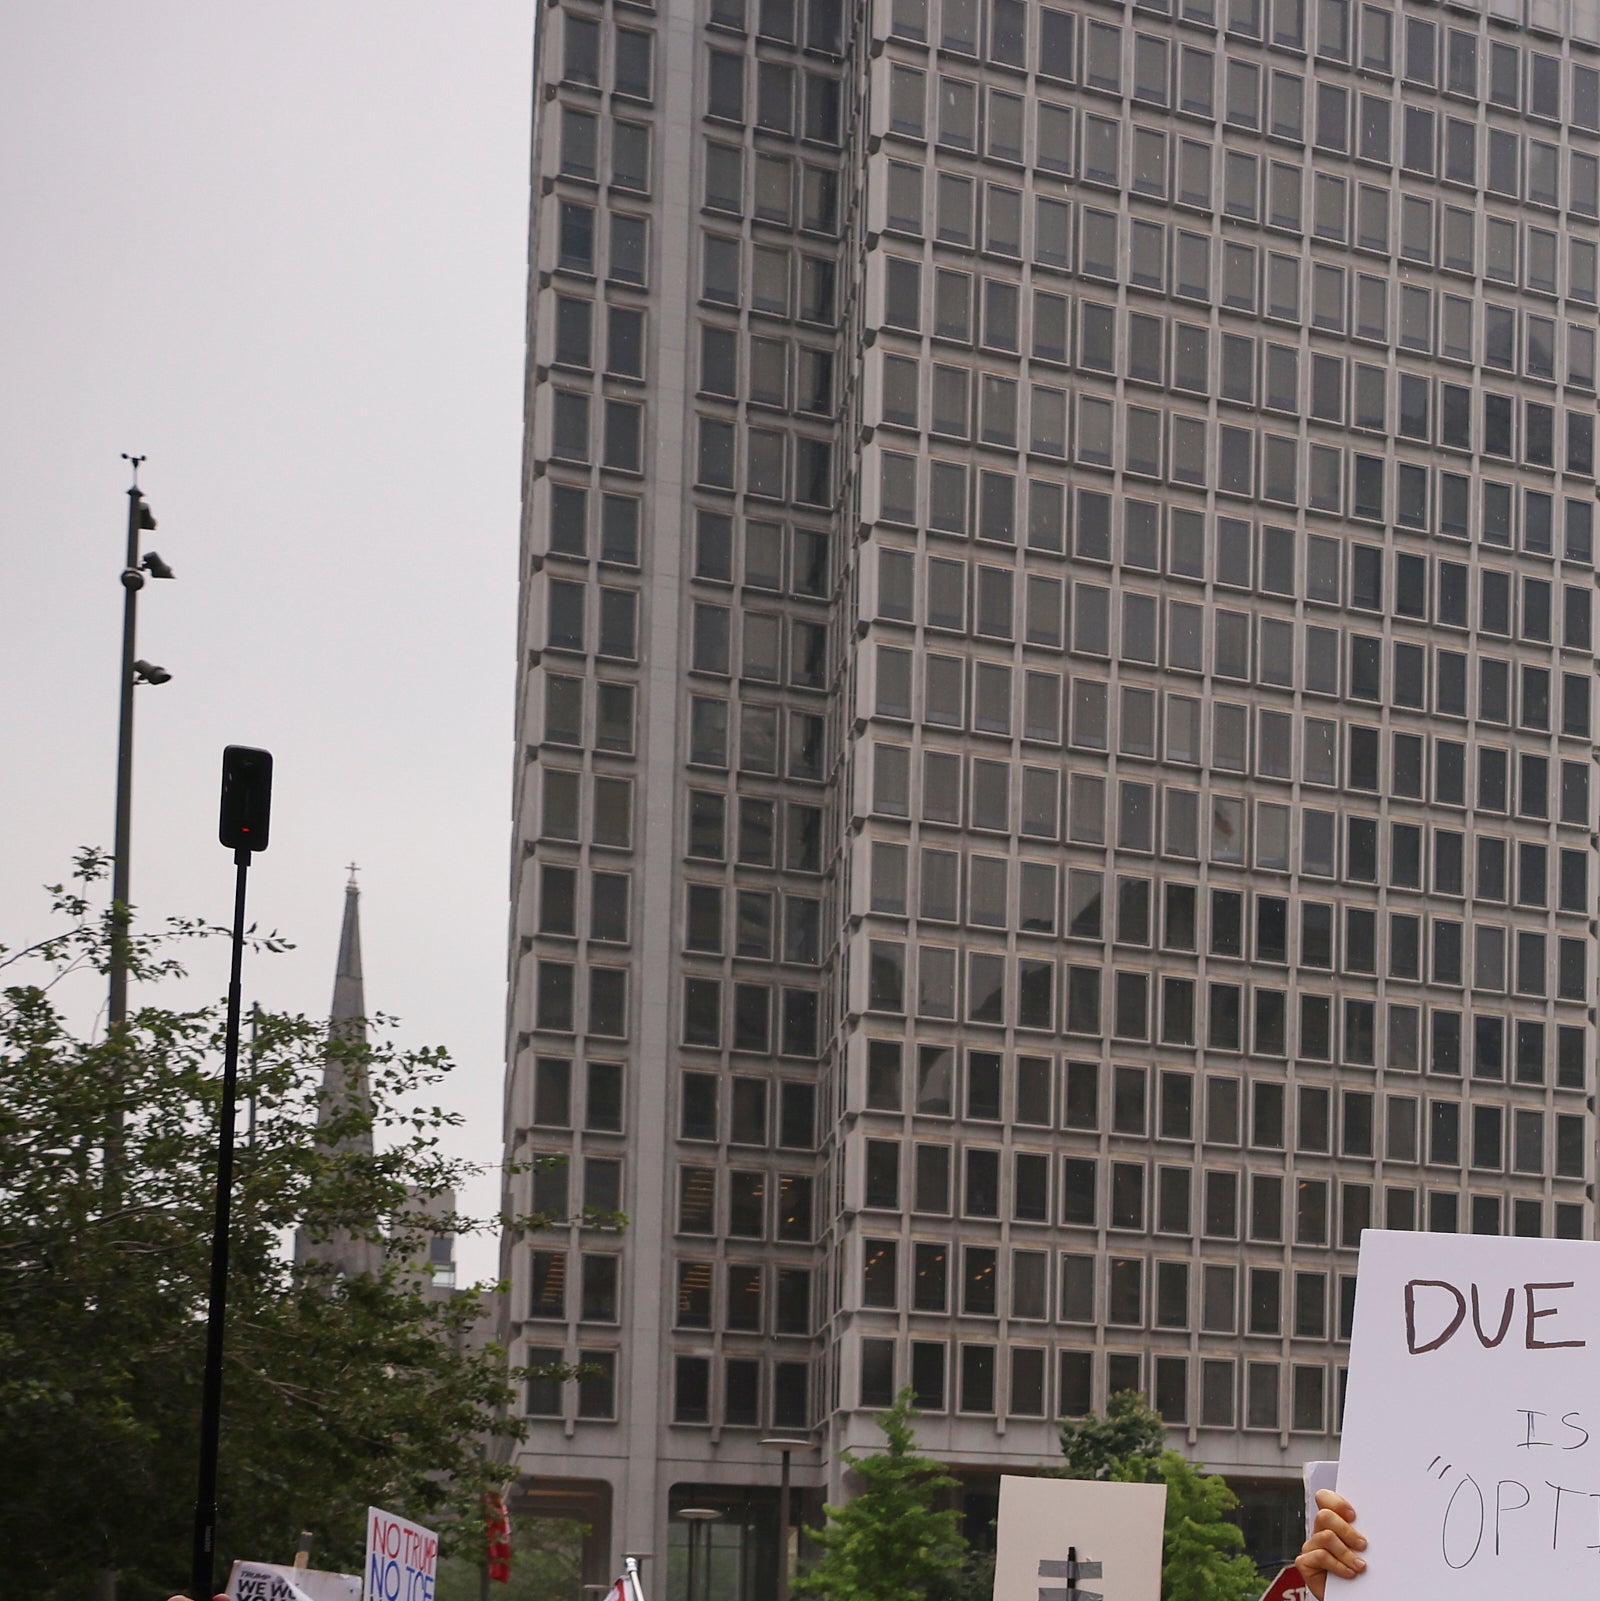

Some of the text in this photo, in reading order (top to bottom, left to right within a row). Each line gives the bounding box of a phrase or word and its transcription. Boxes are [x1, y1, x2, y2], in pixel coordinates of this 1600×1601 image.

[1405, 1280, 1586, 1354] DUE
[1516, 1409, 1589, 1450] IS
[373, 1516, 437, 1574] NO TRUMP
[238, 1579, 265, 1595] WE
